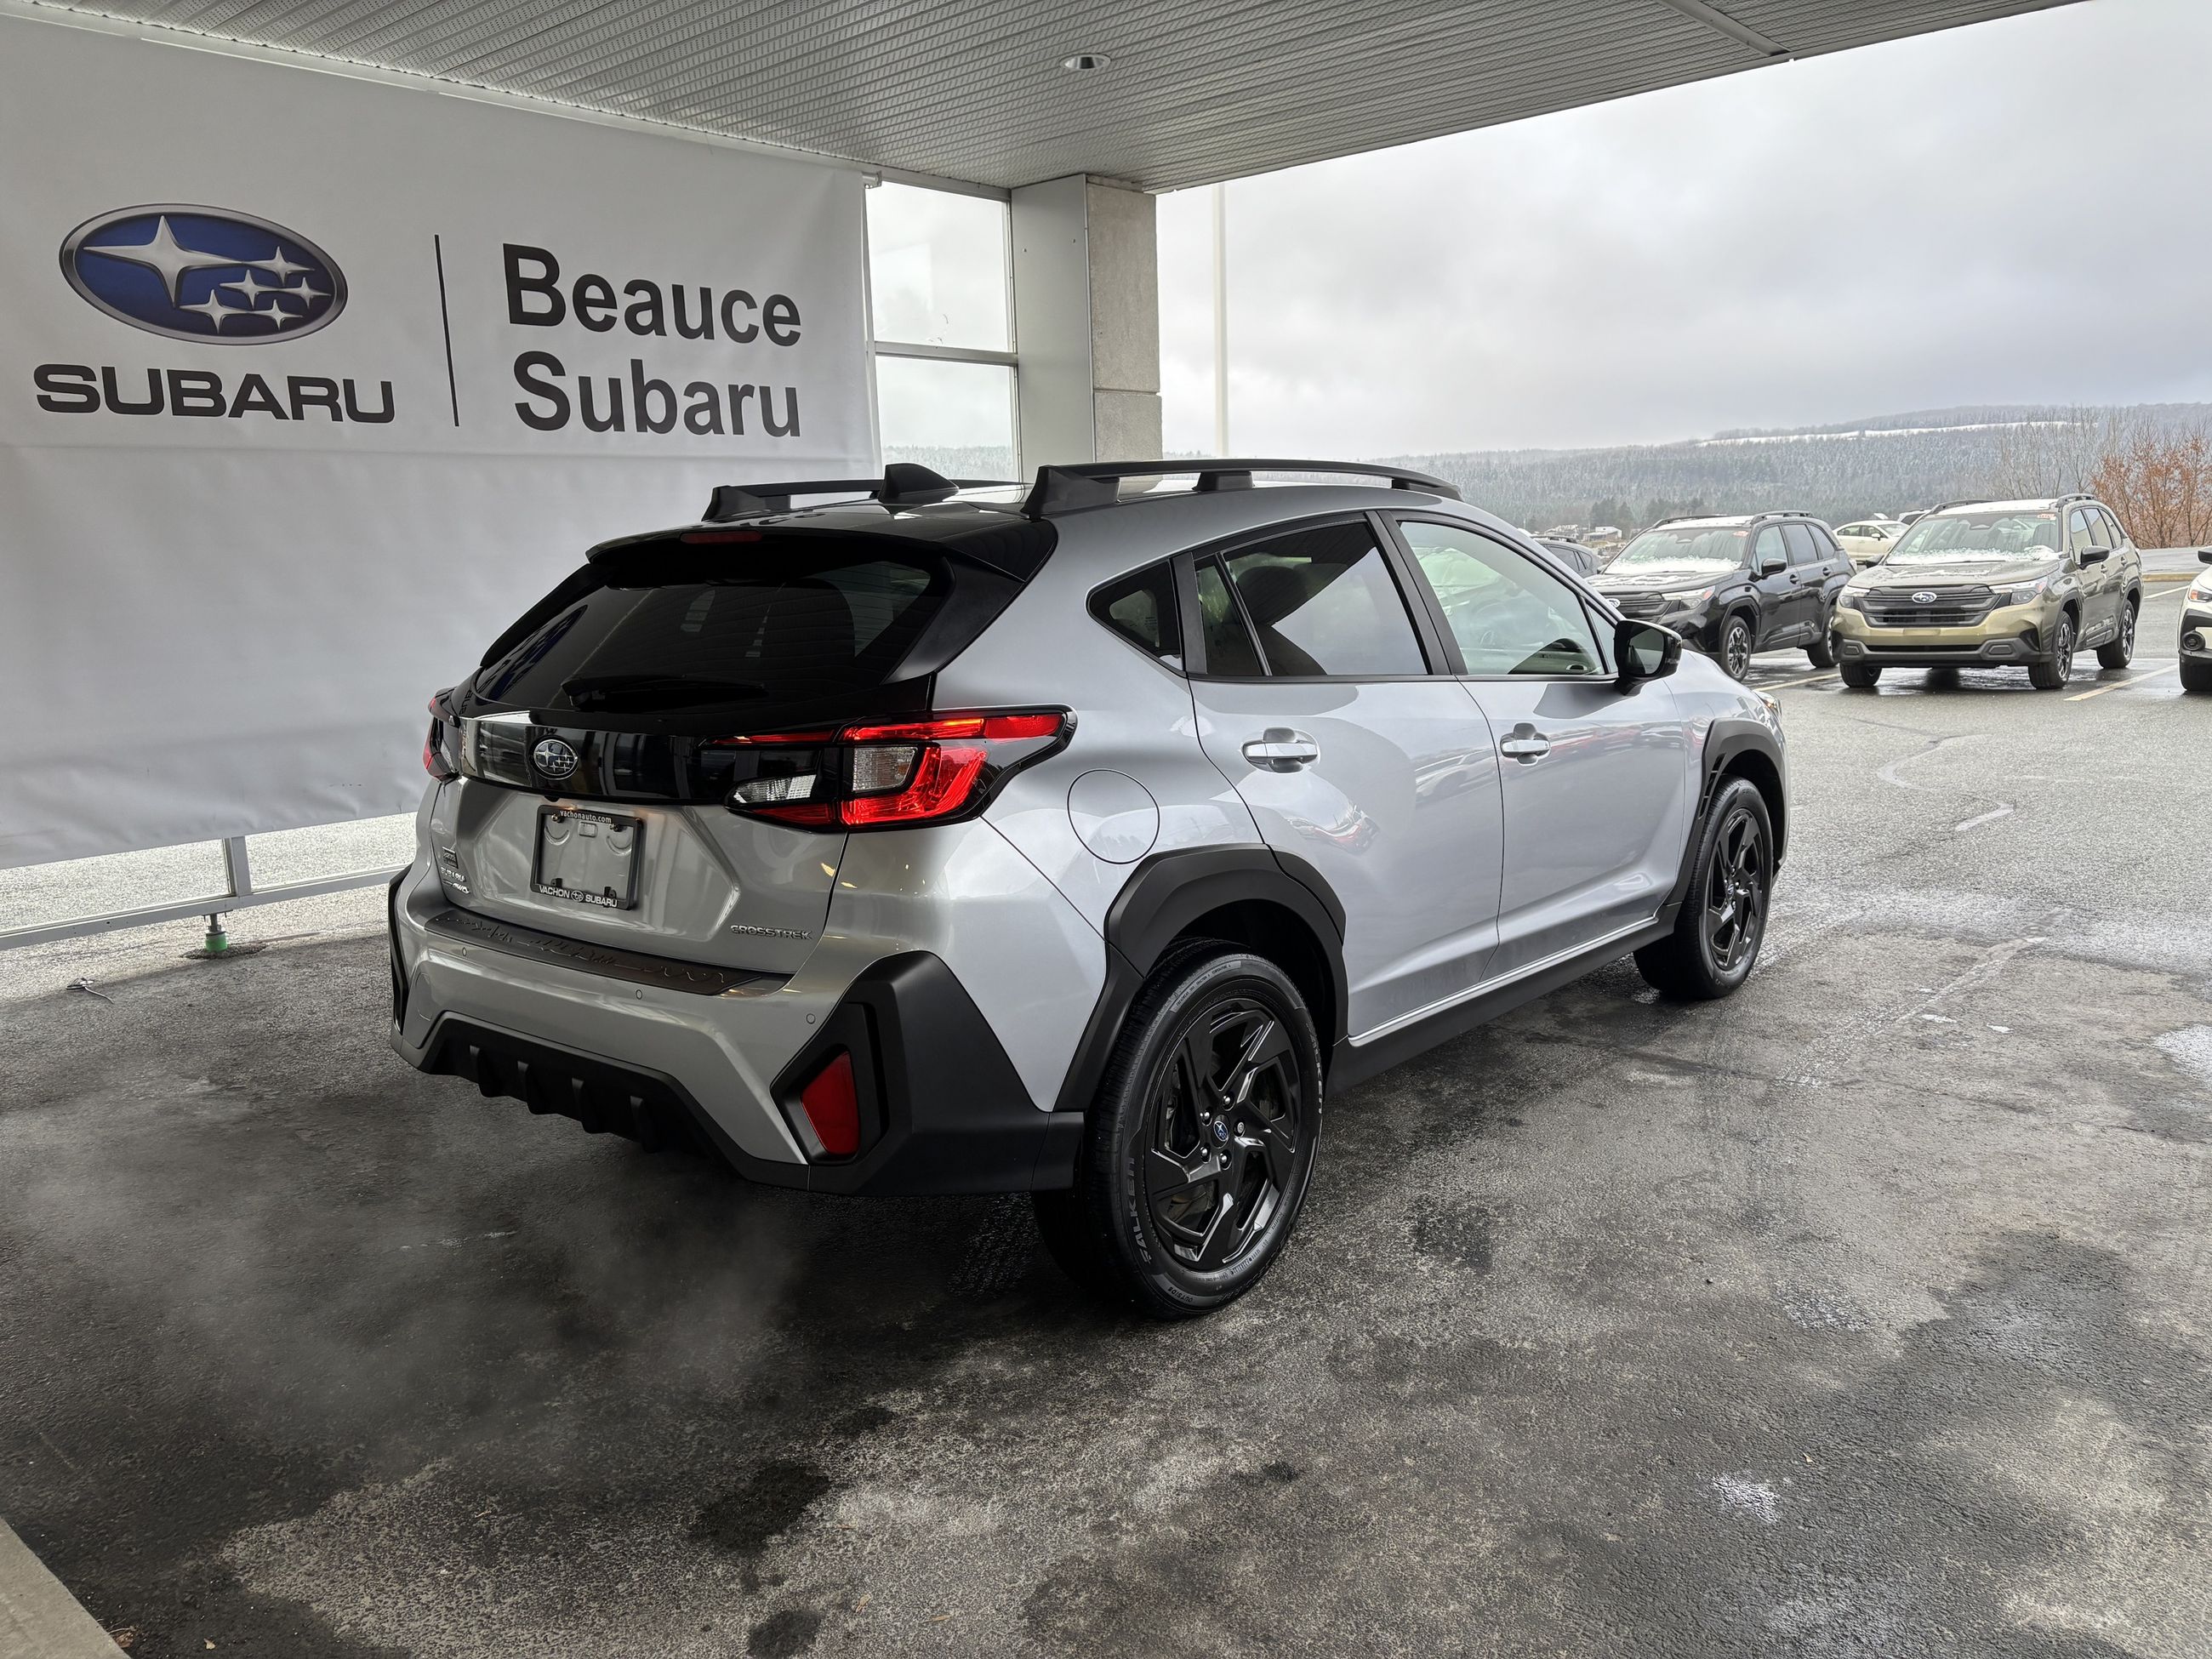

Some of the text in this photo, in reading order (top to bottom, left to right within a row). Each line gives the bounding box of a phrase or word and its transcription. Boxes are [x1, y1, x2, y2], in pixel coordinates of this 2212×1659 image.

[503, 242, 802, 347] Beauce
[32, 362, 396, 425] SUBARU
[514, 350, 801, 438] Subaru
[560, 810, 612, 824] vachonauto.com
[539, 885, 618, 908] VACHON SUBARU
[730, 925, 812, 940] CROSSTREK
